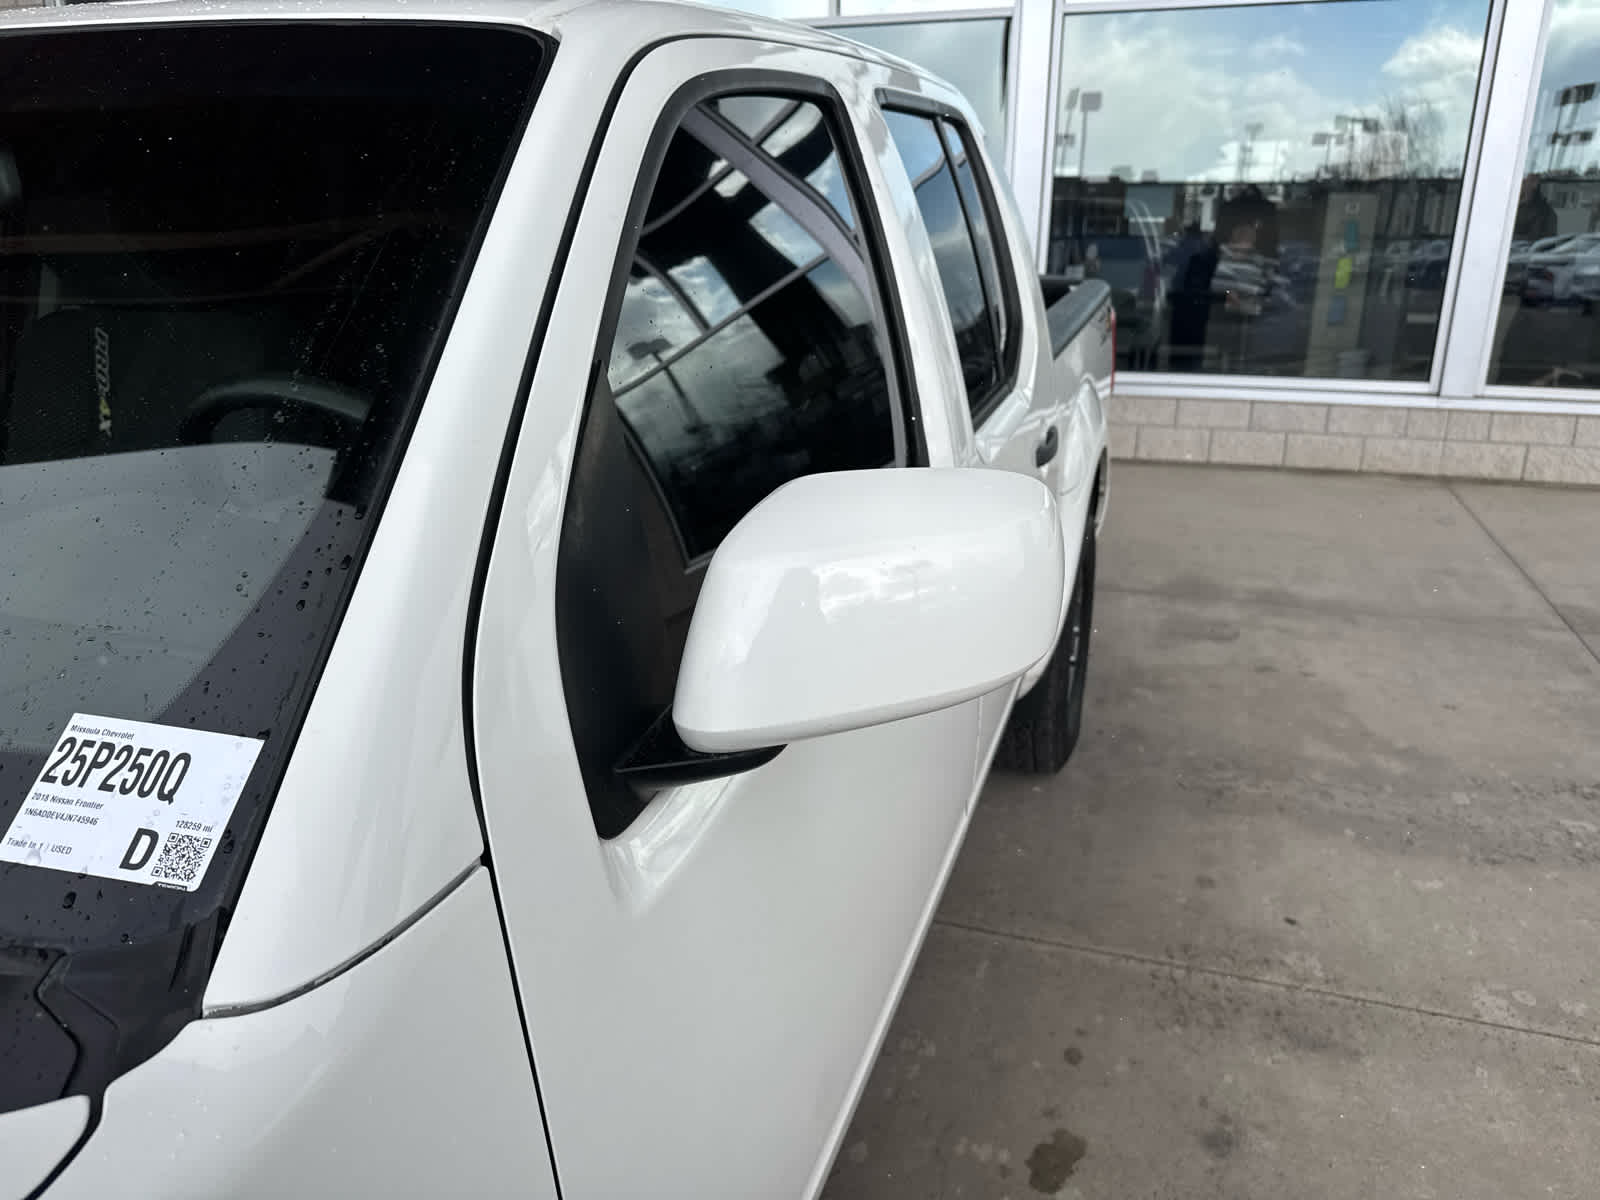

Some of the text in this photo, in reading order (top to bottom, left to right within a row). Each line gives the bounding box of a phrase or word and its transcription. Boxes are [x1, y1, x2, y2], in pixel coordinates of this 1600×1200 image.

[71, 724, 134, 740] Missoula Chevrolet
[40, 736, 192, 805] 25P250Q
[31, 792, 104, 810] 2018 Nissan Frontier
[175, 820, 214, 833] 128259 mi
[7, 837, 28, 848] Trade
[51, 844, 72, 855] USED
[119, 827, 160, 871] D
